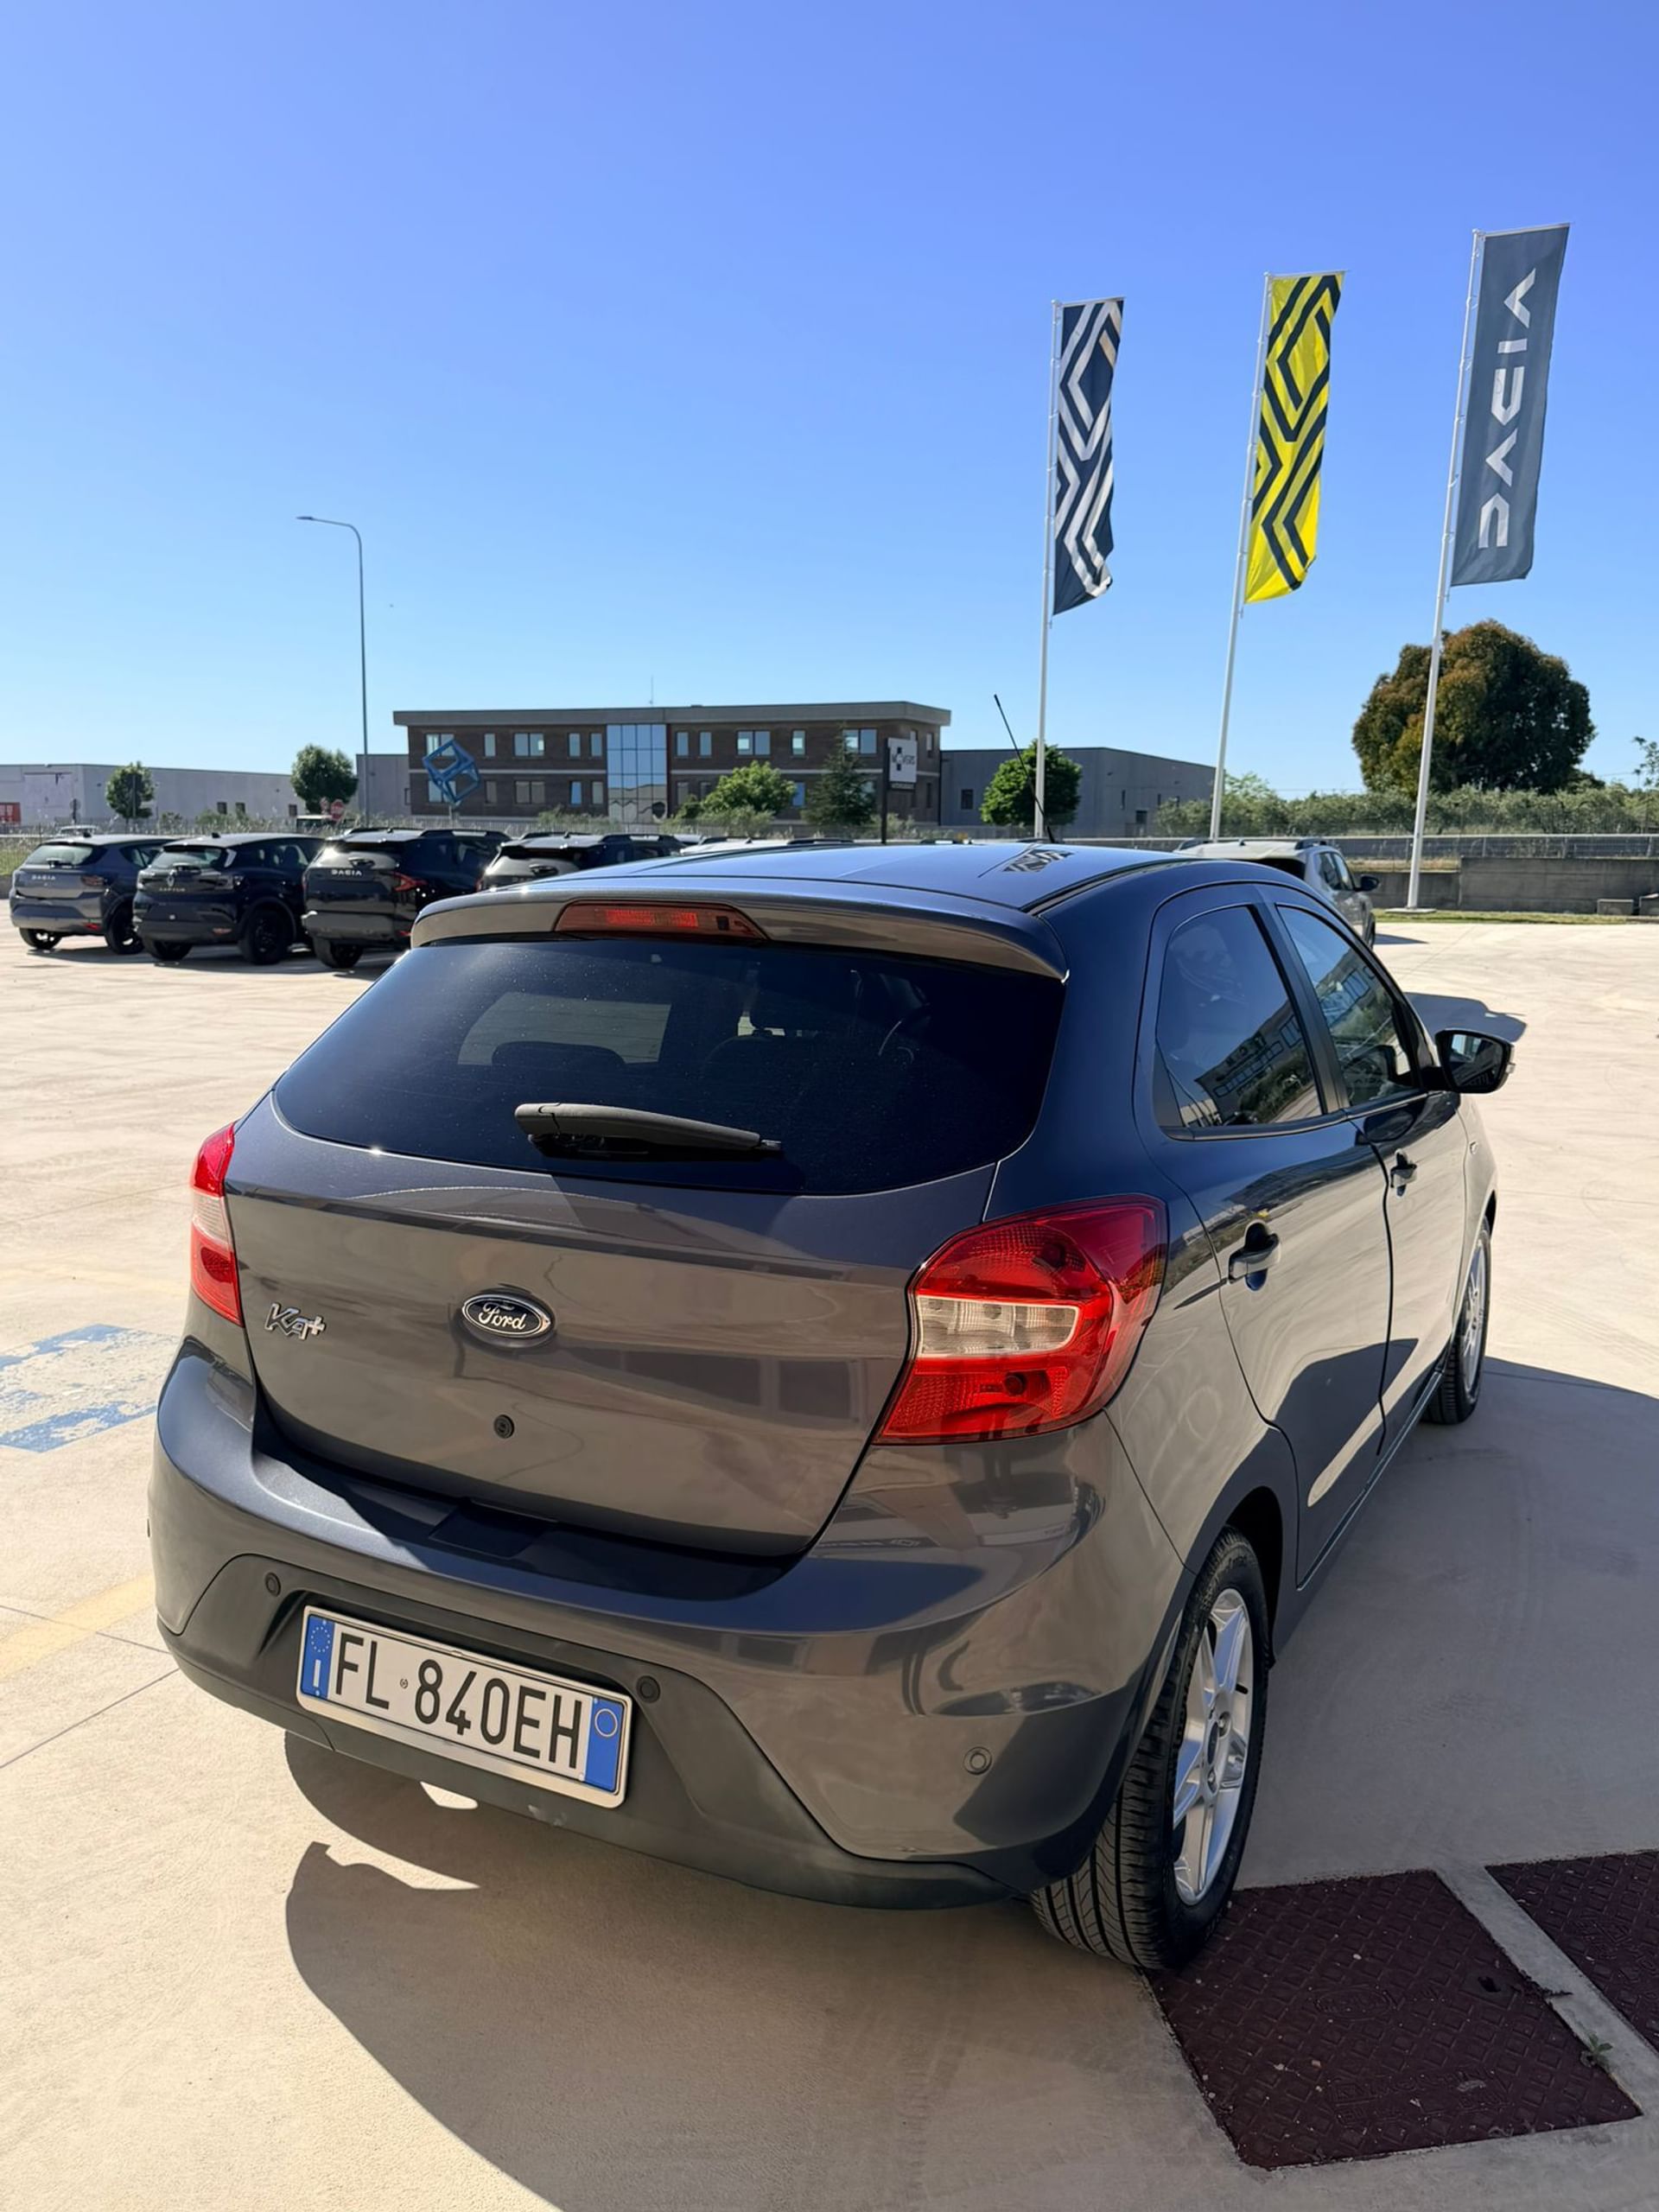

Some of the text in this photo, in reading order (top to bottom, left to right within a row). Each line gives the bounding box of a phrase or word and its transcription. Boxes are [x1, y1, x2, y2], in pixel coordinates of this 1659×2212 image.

[1477, 268, 1537, 550] DACIA
[331, 868, 362, 876] DACIA
[264, 1301, 327, 1340] Ka+
[478, 1301, 527, 1330] Ford
[313, 1631, 582, 1770] I FL 840EH
